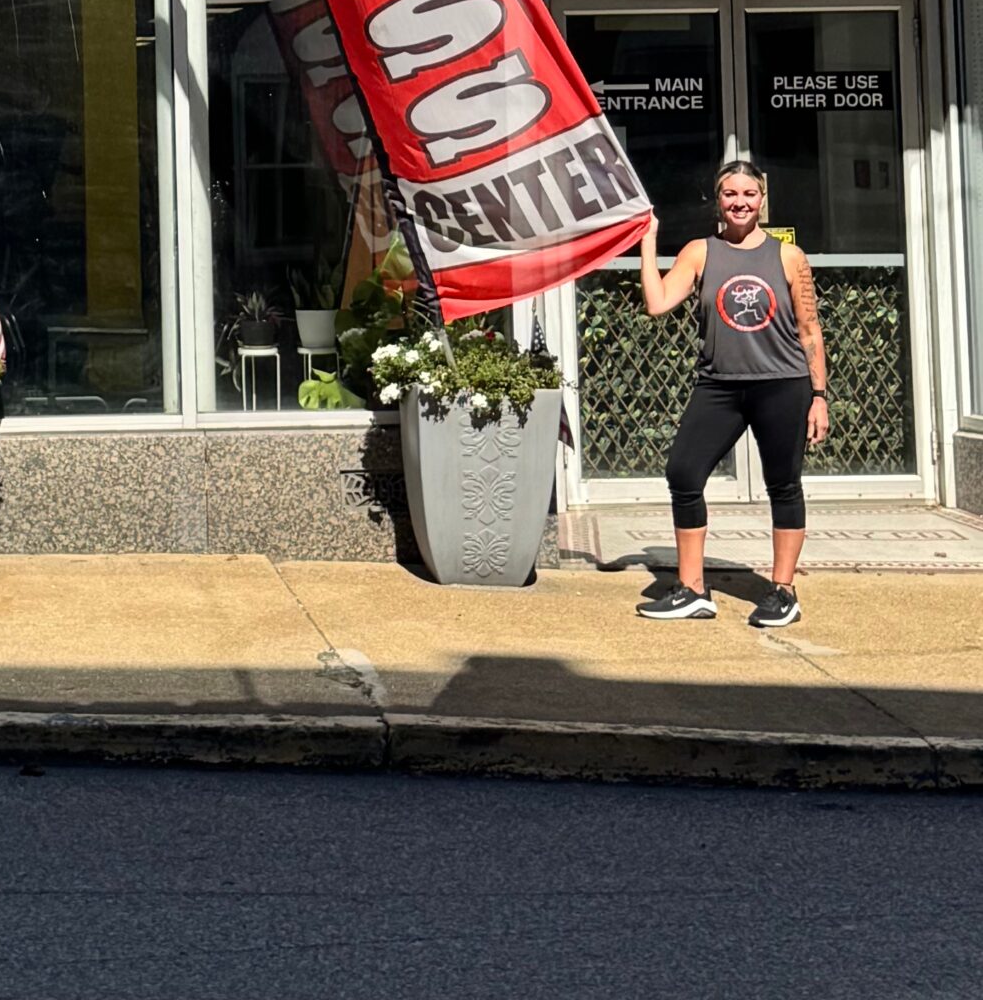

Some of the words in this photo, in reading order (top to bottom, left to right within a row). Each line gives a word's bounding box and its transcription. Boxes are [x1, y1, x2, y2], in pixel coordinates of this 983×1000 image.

[655, 78, 703, 92] MAIN
[773, 76, 838, 90] PLEASE
[844, 75, 879, 89] USE
[598, 96, 704, 111] ENTRANCE
[770, 94, 827, 109] OTHER
[833, 93, 884, 109] DOOR
[410, 132, 640, 254] CENTER
